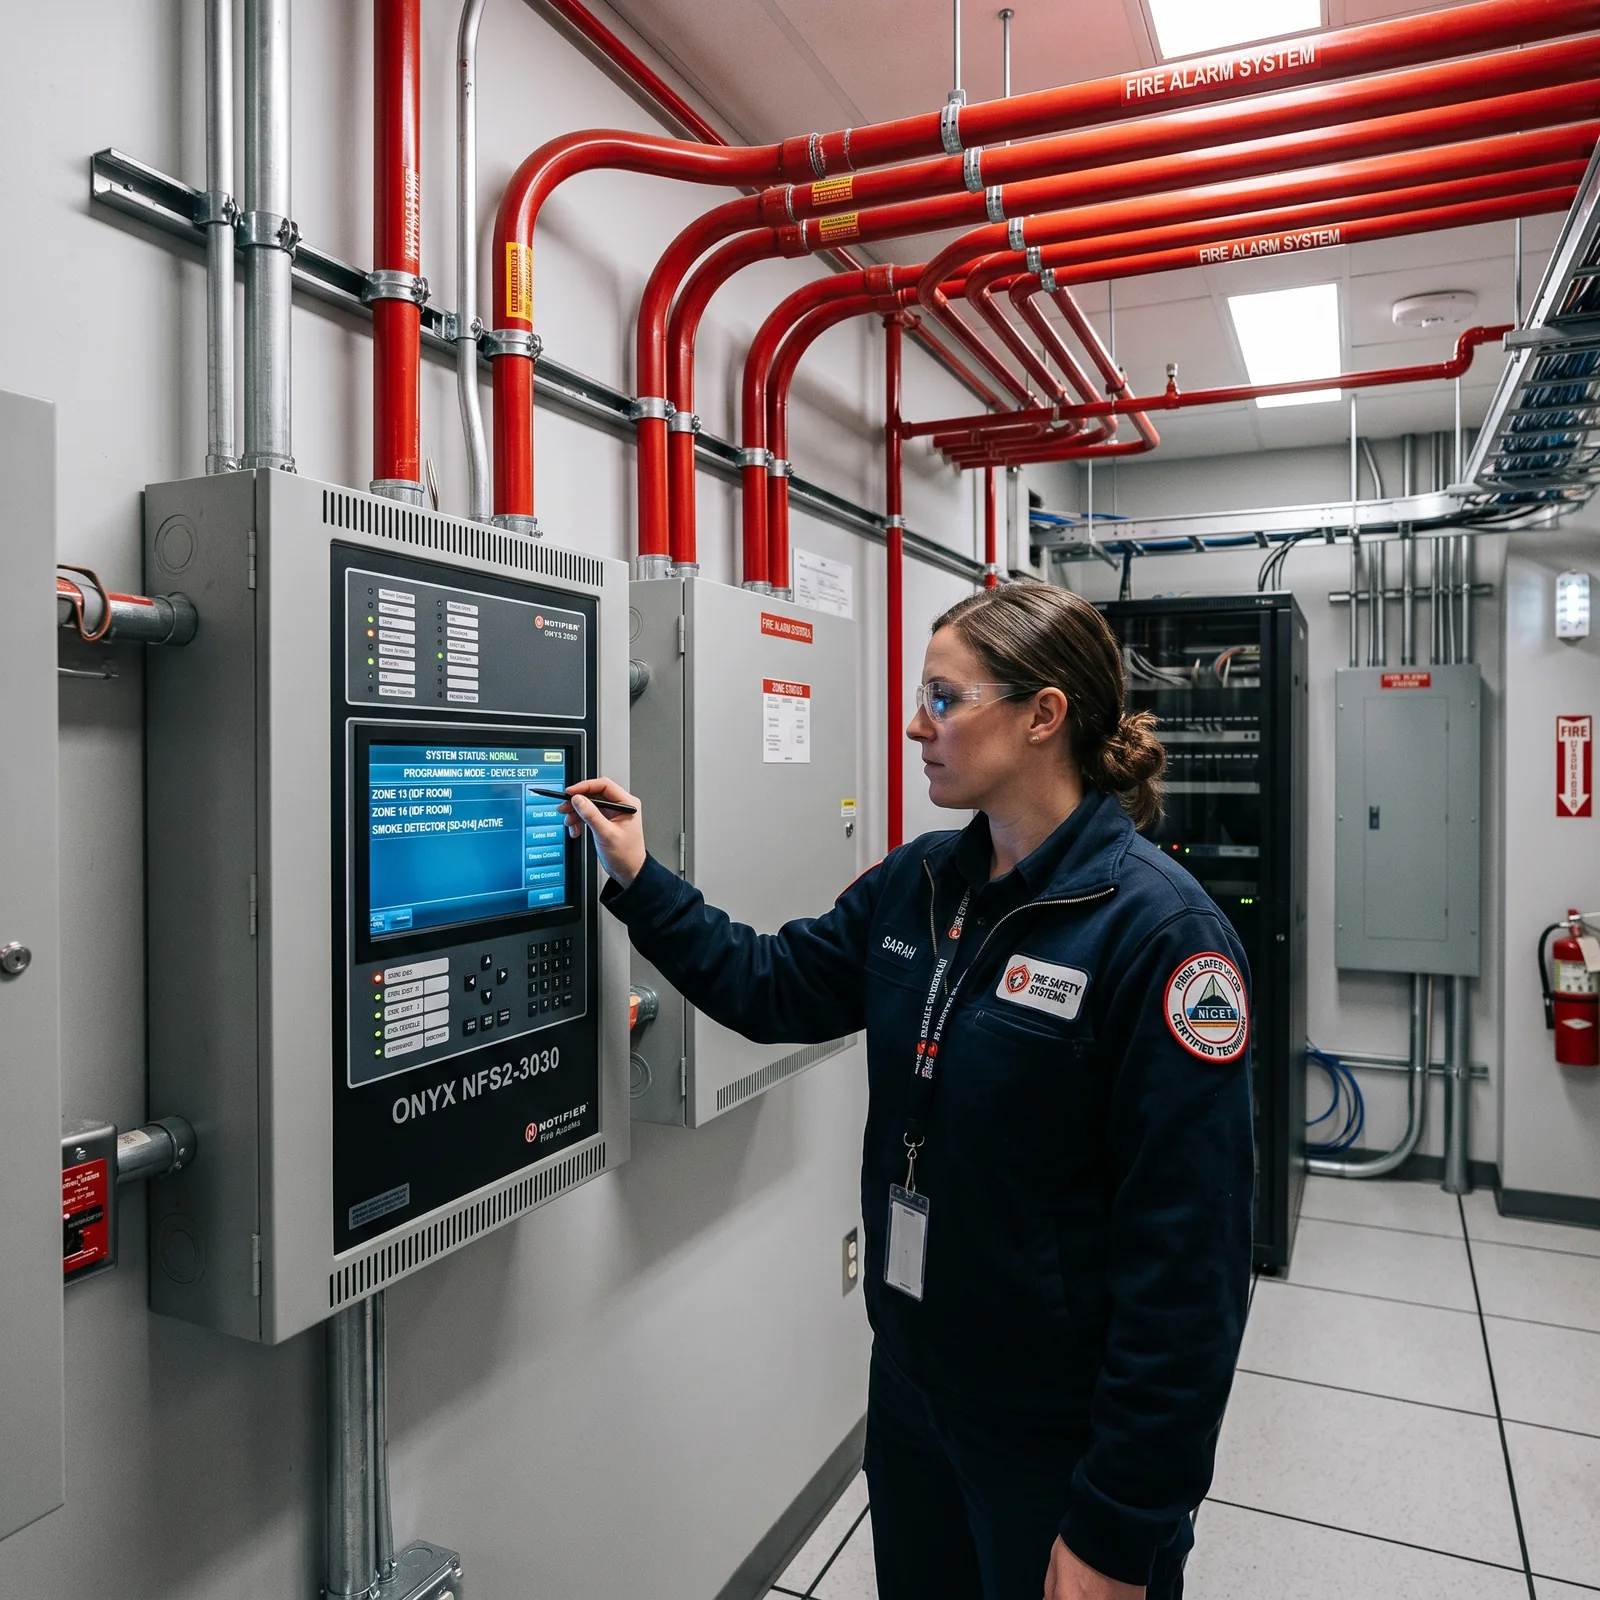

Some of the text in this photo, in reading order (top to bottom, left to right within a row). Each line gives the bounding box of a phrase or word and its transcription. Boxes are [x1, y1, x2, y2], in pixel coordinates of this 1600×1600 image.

[1126, 44, 1315, 99] FIRE ALARM SYSTEM
[1199, 228, 1340, 263] FIRE ALARM SYSTEM
[1561, 725, 1587, 737] FIRE
[425, 750, 519, 761] SYSTEM STATUS: NORMAL
[404, 768, 462, 778] PROGRAMMING
[464, 768, 485, 777] MODE
[490, 768, 516, 777] DEVICE
[517, 768, 539, 777] SETUP
[372, 788, 452, 800] ZONE 13 (IDF ROOM)
[372, 805, 452, 817] ZONE 16 (IDF ROOM)
[372, 817, 503, 835] SMOKE DETECTOR [SD-014] ACTIVE
[882, 936, 917, 960] SARAH
[1048, 977, 1082, 996] SAFETY
[1198, 1009, 1232, 1019] NICET
[1172, 1013, 1214, 1055] CERTIFIED
[392, 1047, 560, 1124] ONYX NFS2-3030
[539, 1103, 587, 1132] NOTIFIER
